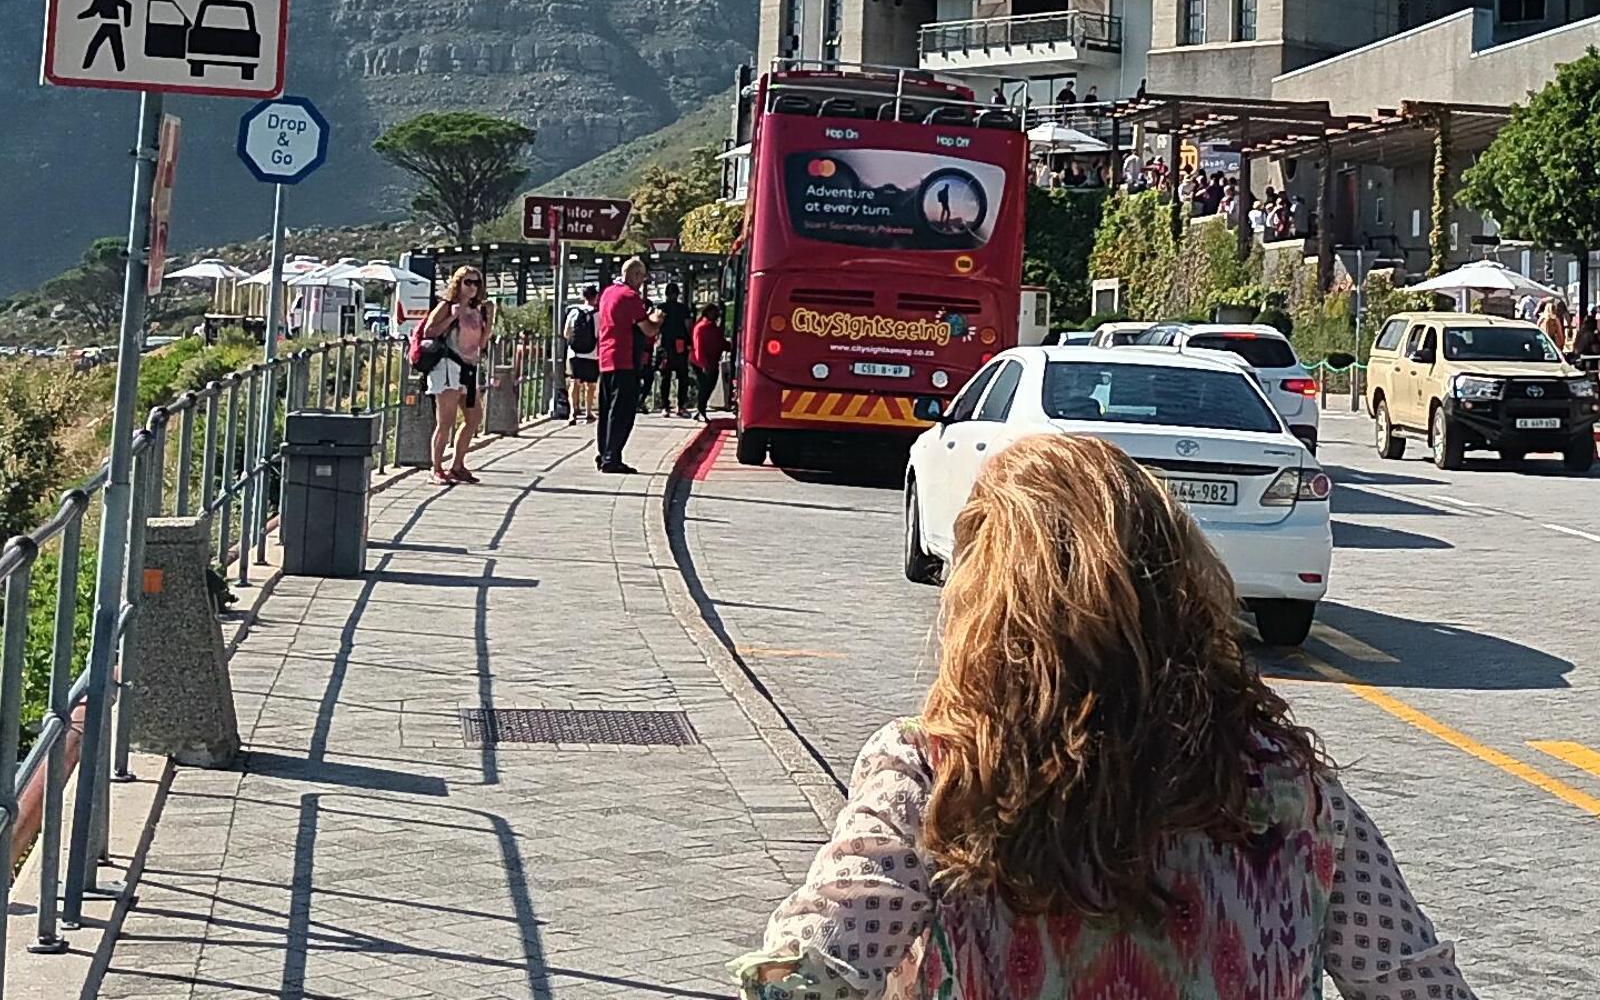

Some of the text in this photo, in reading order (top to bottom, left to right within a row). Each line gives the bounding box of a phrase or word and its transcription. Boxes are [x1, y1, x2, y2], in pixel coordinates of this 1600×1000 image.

[267, 114, 307, 133] Drop
[277, 131, 290, 147] &
[826, 128, 859, 139] Hop On
[937, 135, 971, 147] Hop Off
[271, 149, 293, 166] Go
[806, 184, 875, 199] Adventure
[805, 202, 820, 212] at
[823, 203, 860, 216] every
[791, 307, 951, 346] CitySightseeing
